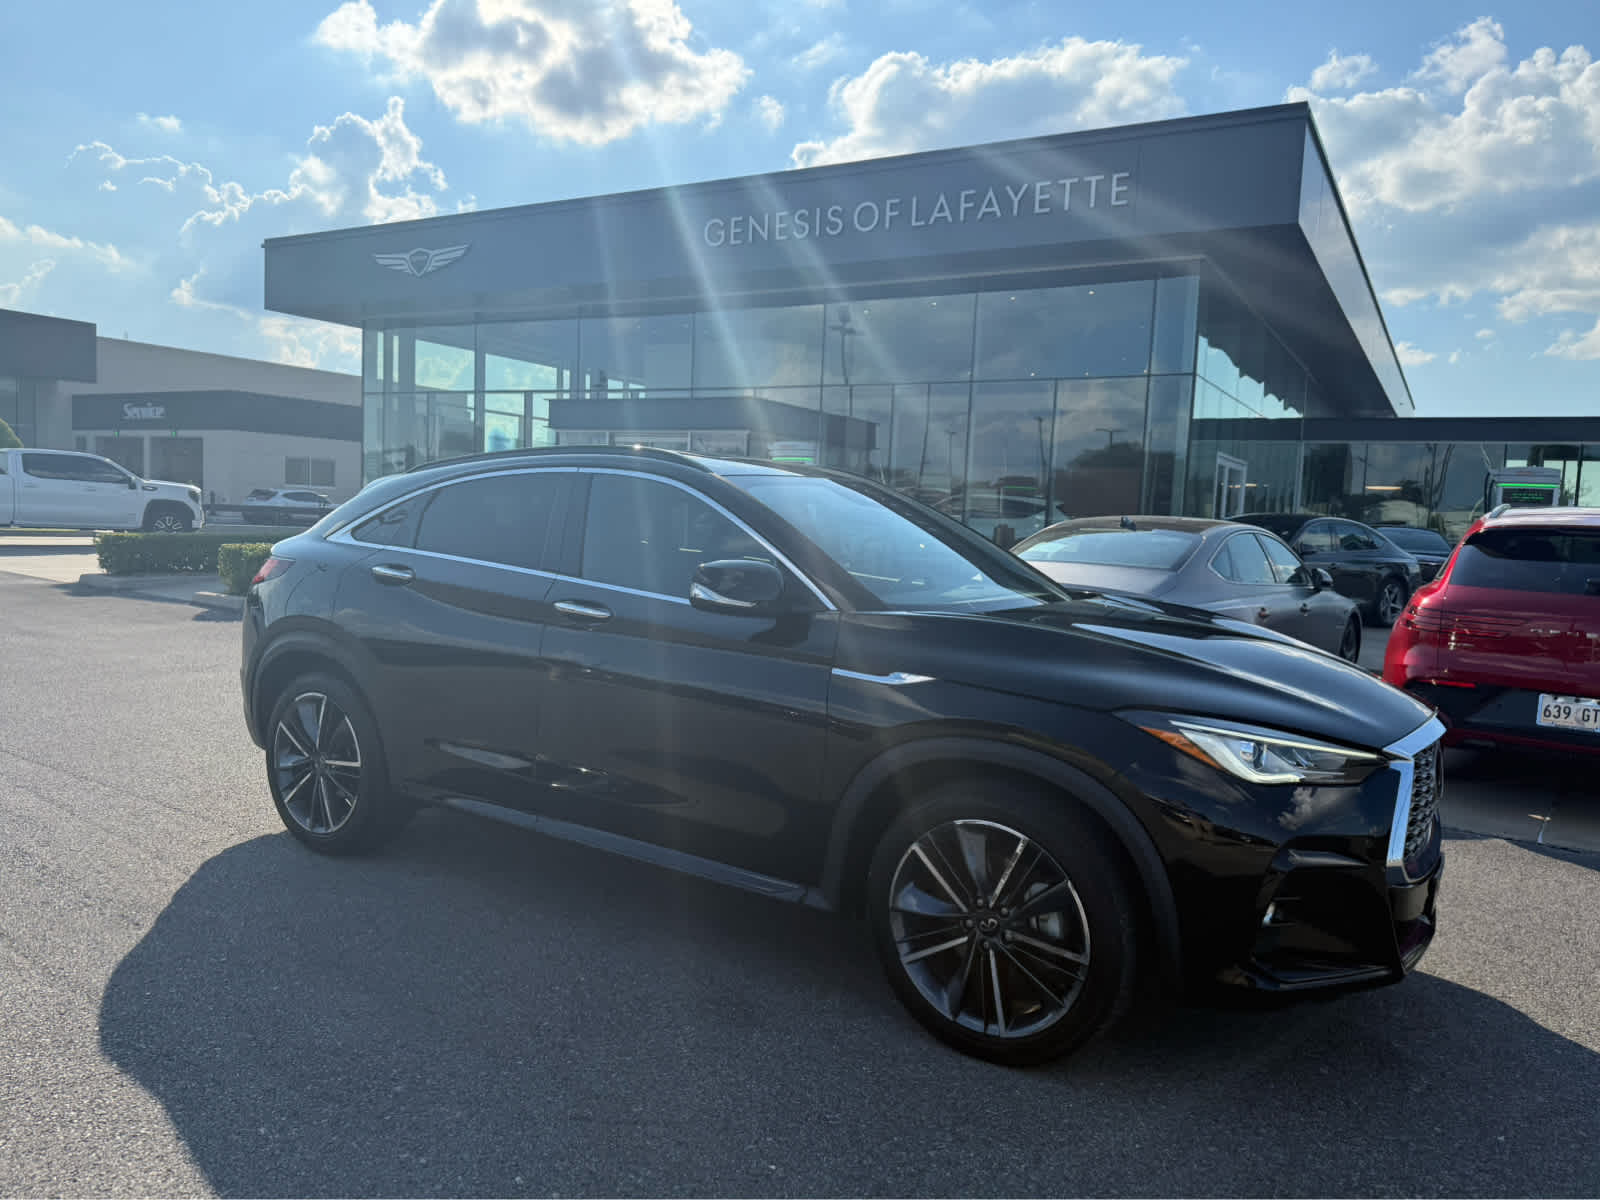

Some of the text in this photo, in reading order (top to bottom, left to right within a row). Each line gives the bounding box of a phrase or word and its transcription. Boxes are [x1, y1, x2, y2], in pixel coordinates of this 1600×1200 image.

[704, 172, 1130, 247] GENESIS OF LAFAYETTE
[121, 402, 166, 420] Service
[1543, 704, 1571, 720] 639
